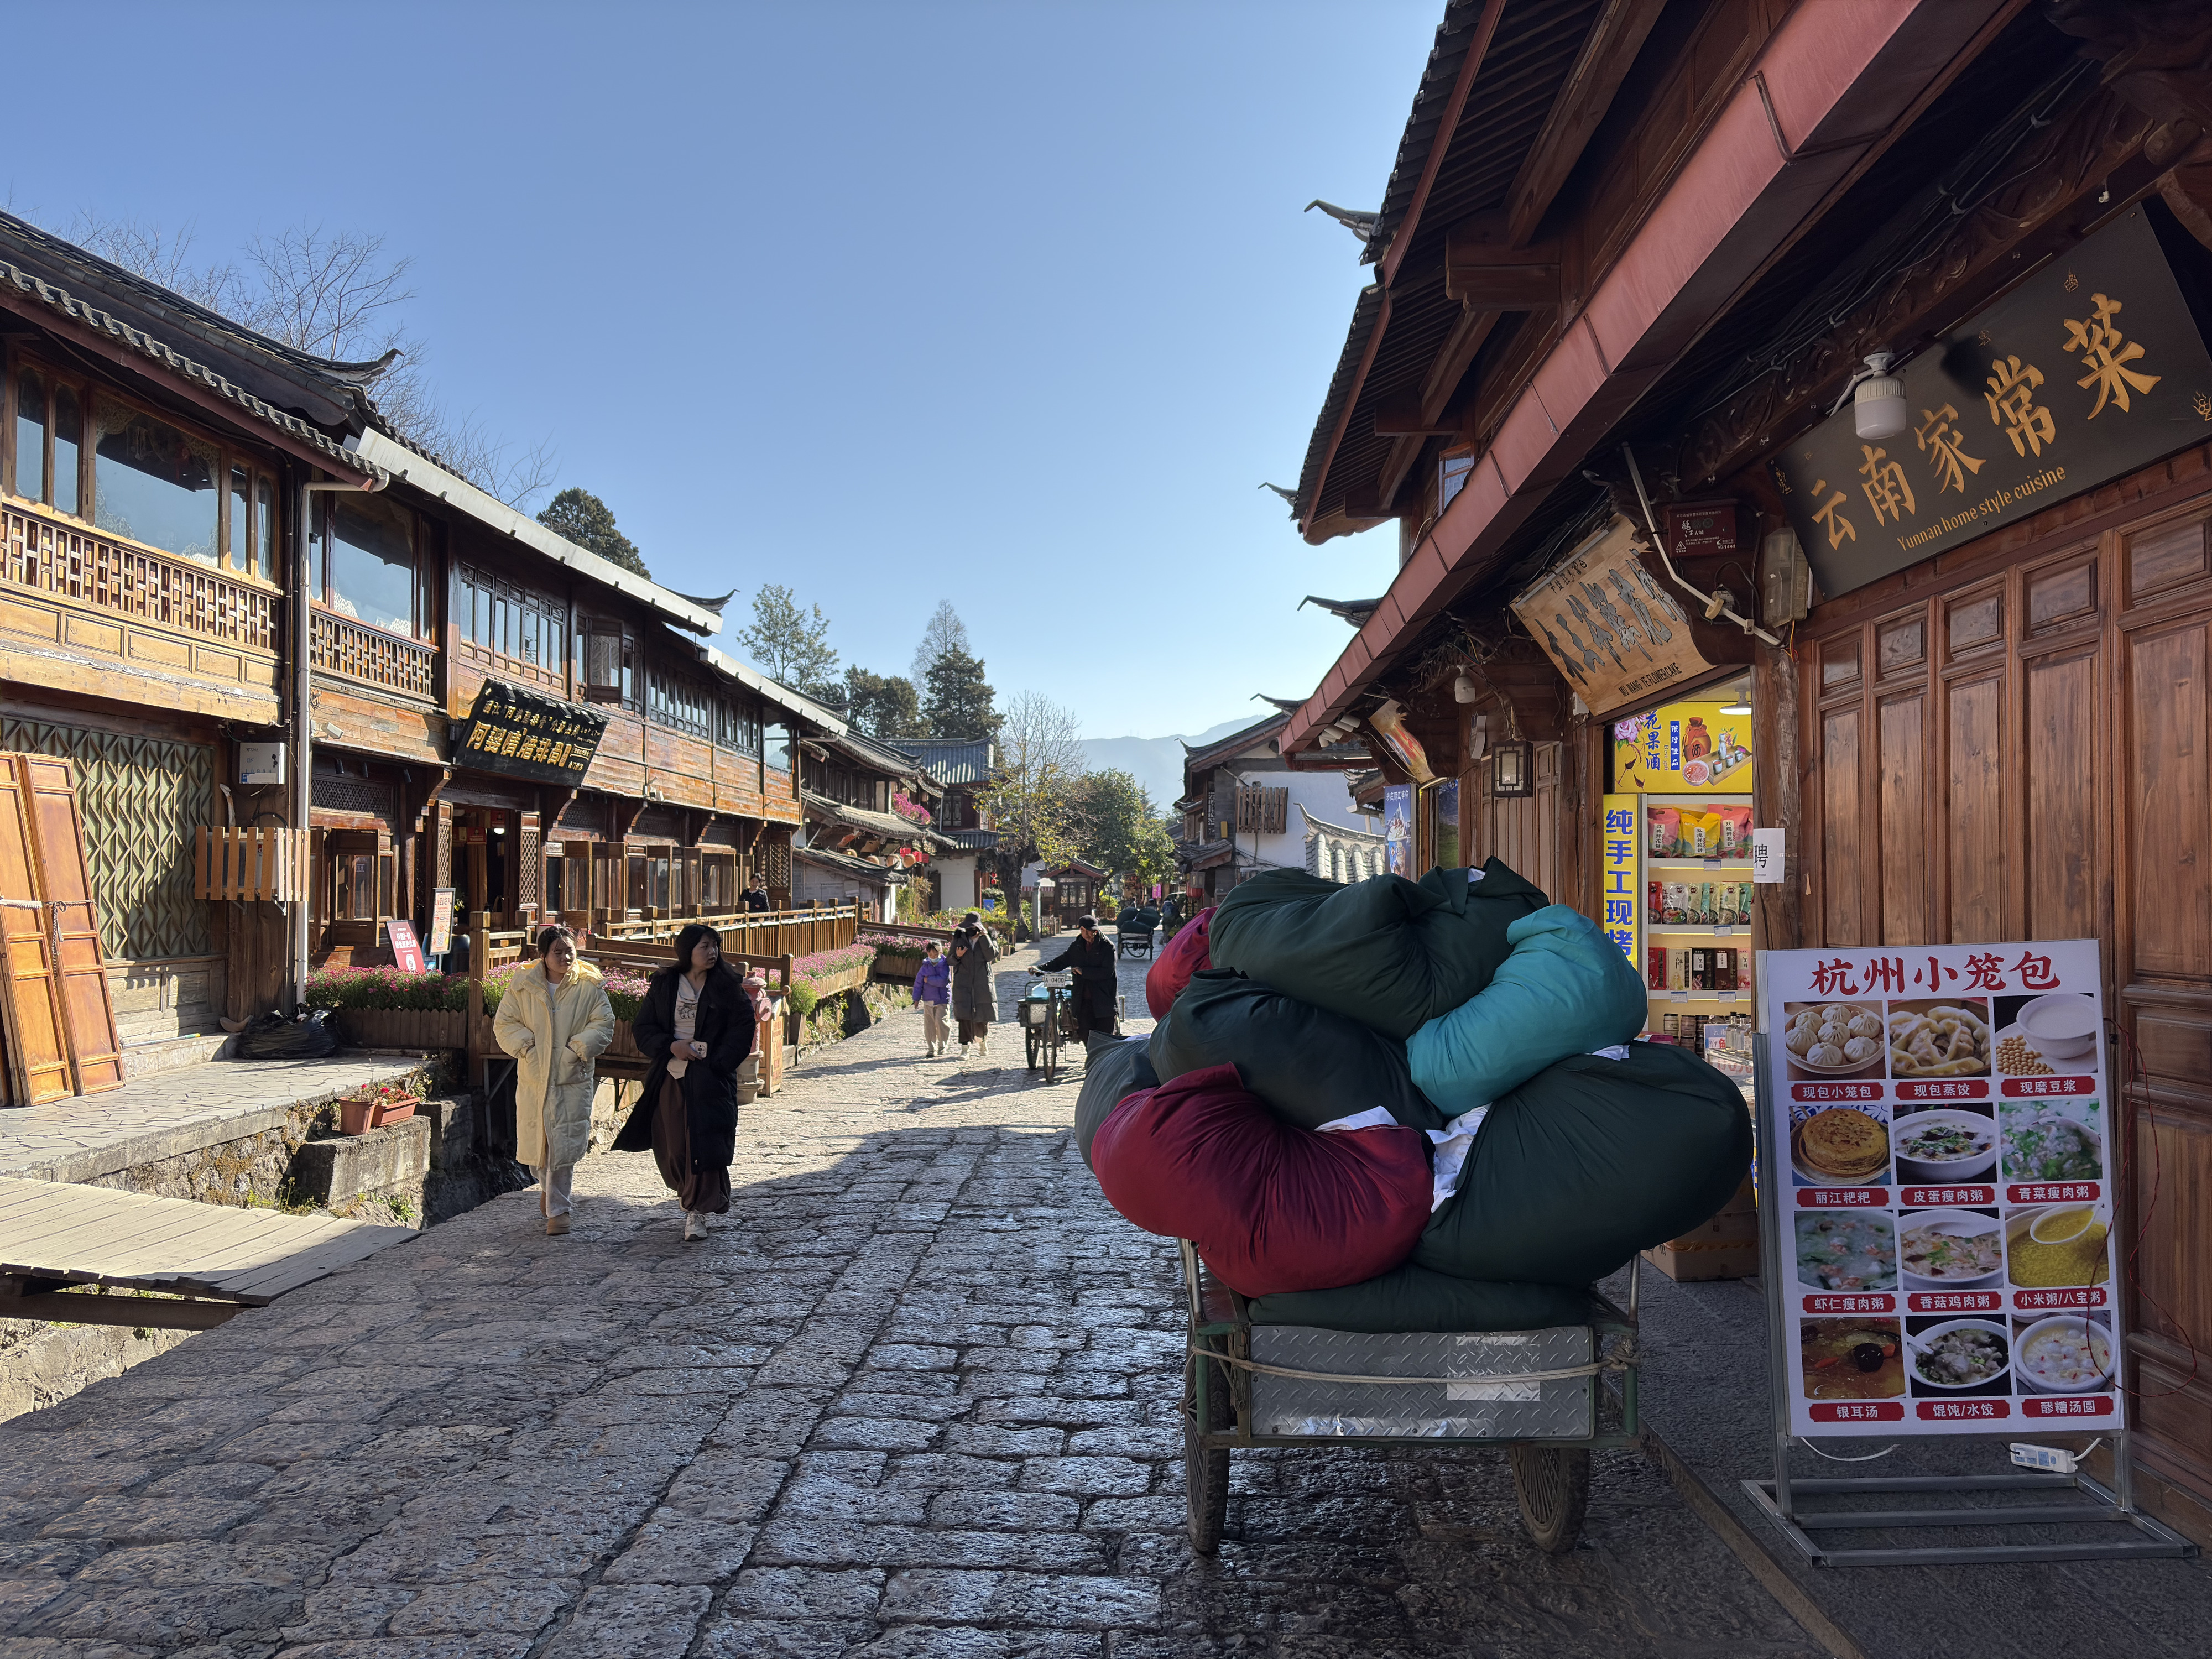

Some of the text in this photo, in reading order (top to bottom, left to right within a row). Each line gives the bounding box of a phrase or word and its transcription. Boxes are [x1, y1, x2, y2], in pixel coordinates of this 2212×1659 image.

[1811, 293, 2162, 550] 云南家常菜
[1897, 466, 2067, 551] Yunnan home style cuisine
[1618, 686, 1630, 697] MU
[1626, 680, 1643, 694] WANG
[1639, 676, 1651, 687] YE
[1644, 709, 1662, 771] 花果酒
[1671, 724, 1679, 766] 馈赠佳品
[1692, 744, 1701, 757] 酒
[1386, 790, 1409, 801] 我在丽江等你
[1754, 843, 1769, 868] 聘
[1606, 809, 1634, 967] 纯手工现烤
[1807, 951, 2061, 996] 杭州小笼包
[1803, 1086, 1872, 1098] 现包小笼包
[1914, 1083, 1970, 1097] 现包蒸饺
[2020, 1079, 2077, 1094] 现磨豆浆
[1815, 1191, 1871, 1204] 丽江粑粑
[1913, 1189, 1983, 1203] 皮蛋瘦肉粥
[2018, 1185, 2089, 1201] 青菜瘦肉粥
[1814, 1297, 1884, 1311] 虾仁瘦肉粥
[1919, 1295, 1990, 1309] 香菇鸡肉粥
[2021, 1291, 2100, 1306] 小米粥/八宝粥
[1836, 1405, 1878, 1419] 银耳汤
[1933, 1403, 1994, 1417] 馄饨/水饺
[2040, 1400, 2096, 1414] 醪糟汤圆
